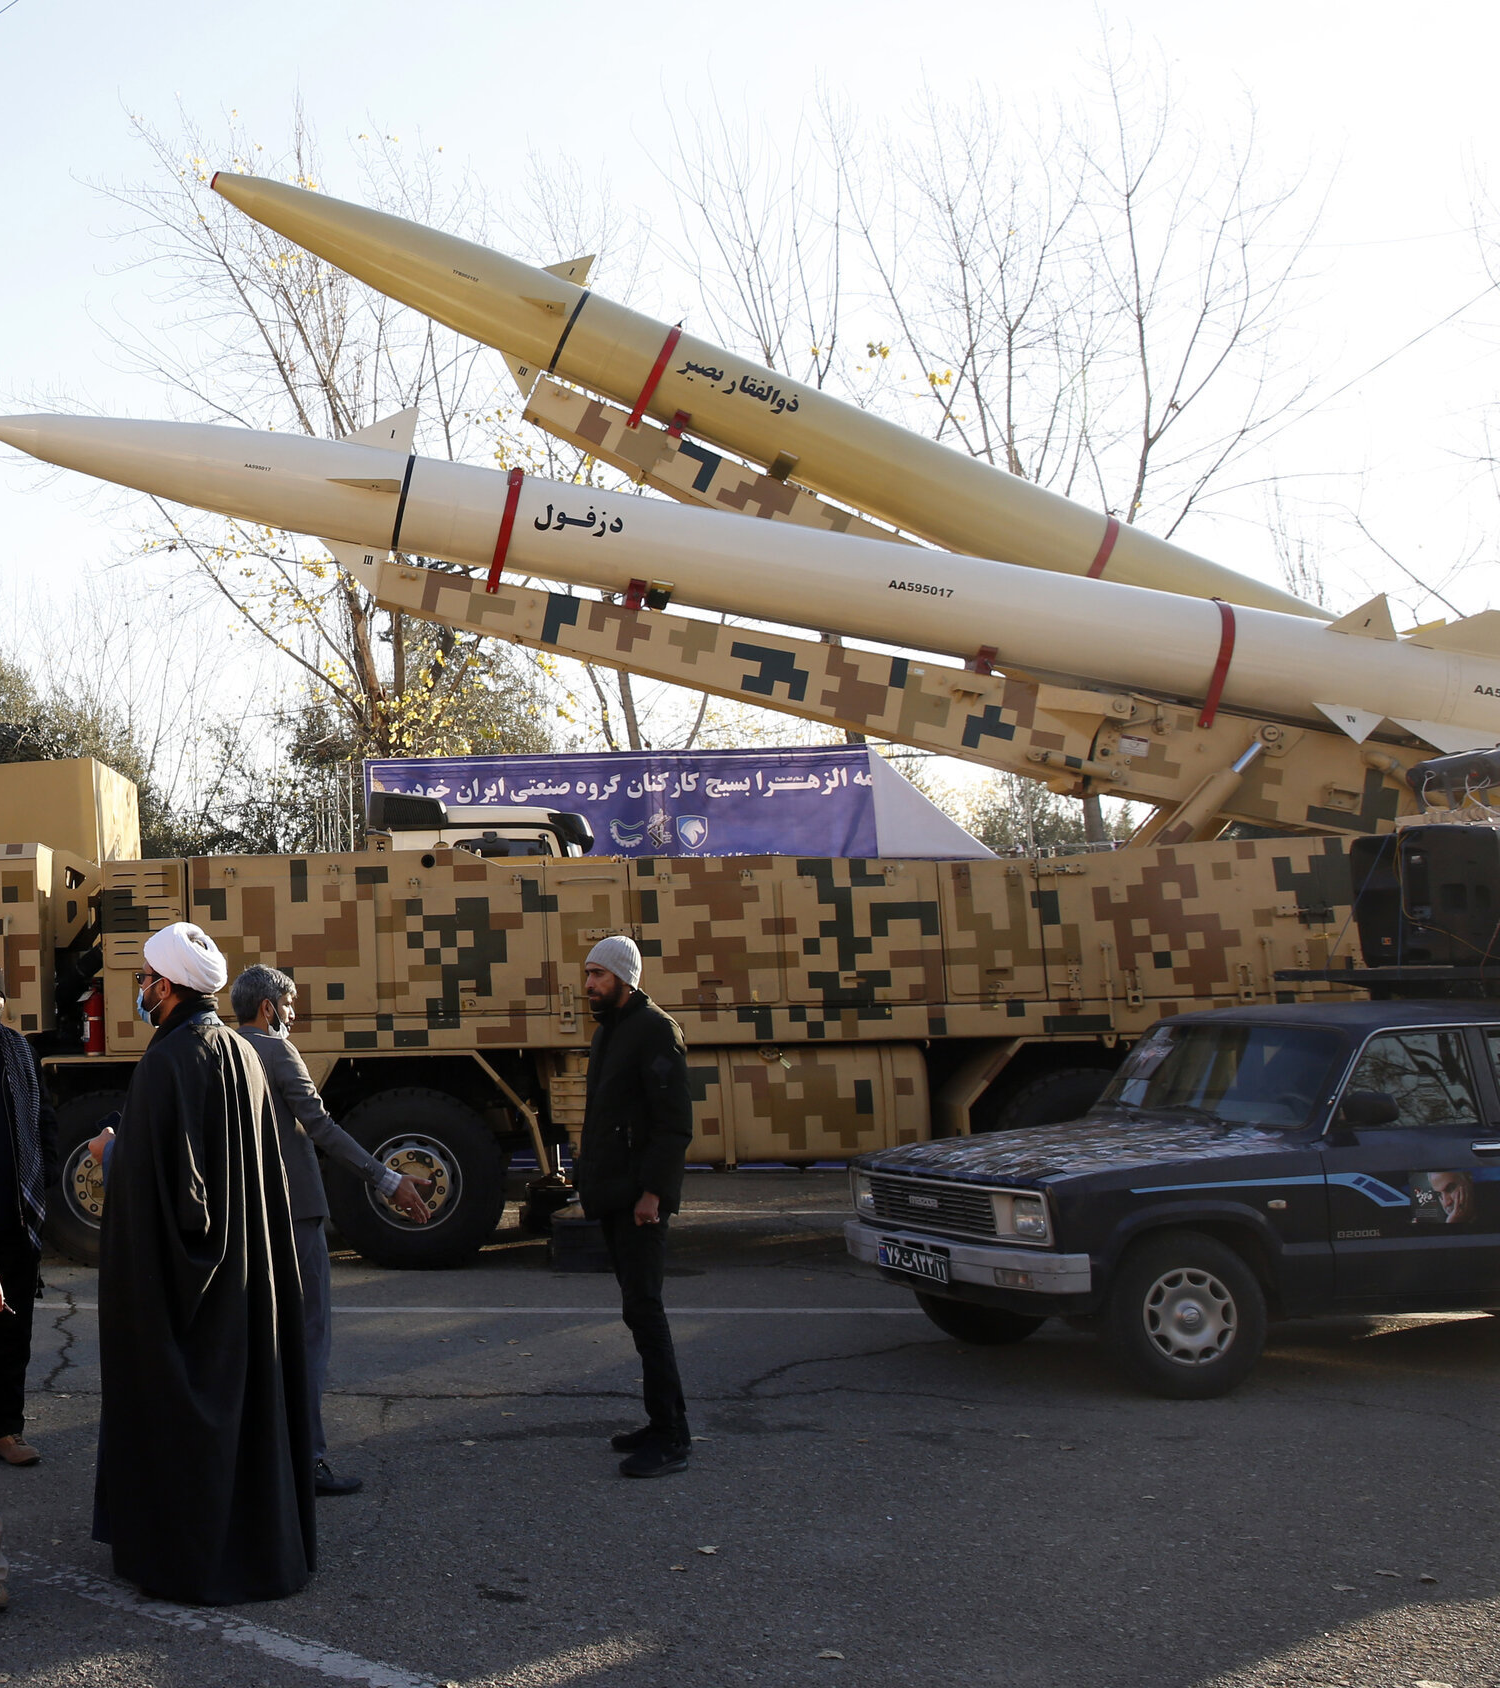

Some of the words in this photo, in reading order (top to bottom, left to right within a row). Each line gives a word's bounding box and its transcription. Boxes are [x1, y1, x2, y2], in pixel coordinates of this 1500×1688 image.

[676, 361, 724, 388] بصیر
[721, 375, 799, 414] ذوالفقار
[534, 504, 623, 537] دزفول
[888, 580, 954, 598] AA595017
[456, 776, 505, 804] ایران
[510, 778, 570, 803] صنعتی
[575, 773, 620, 800] گروه
[706, 775, 751, 798] بسیج
